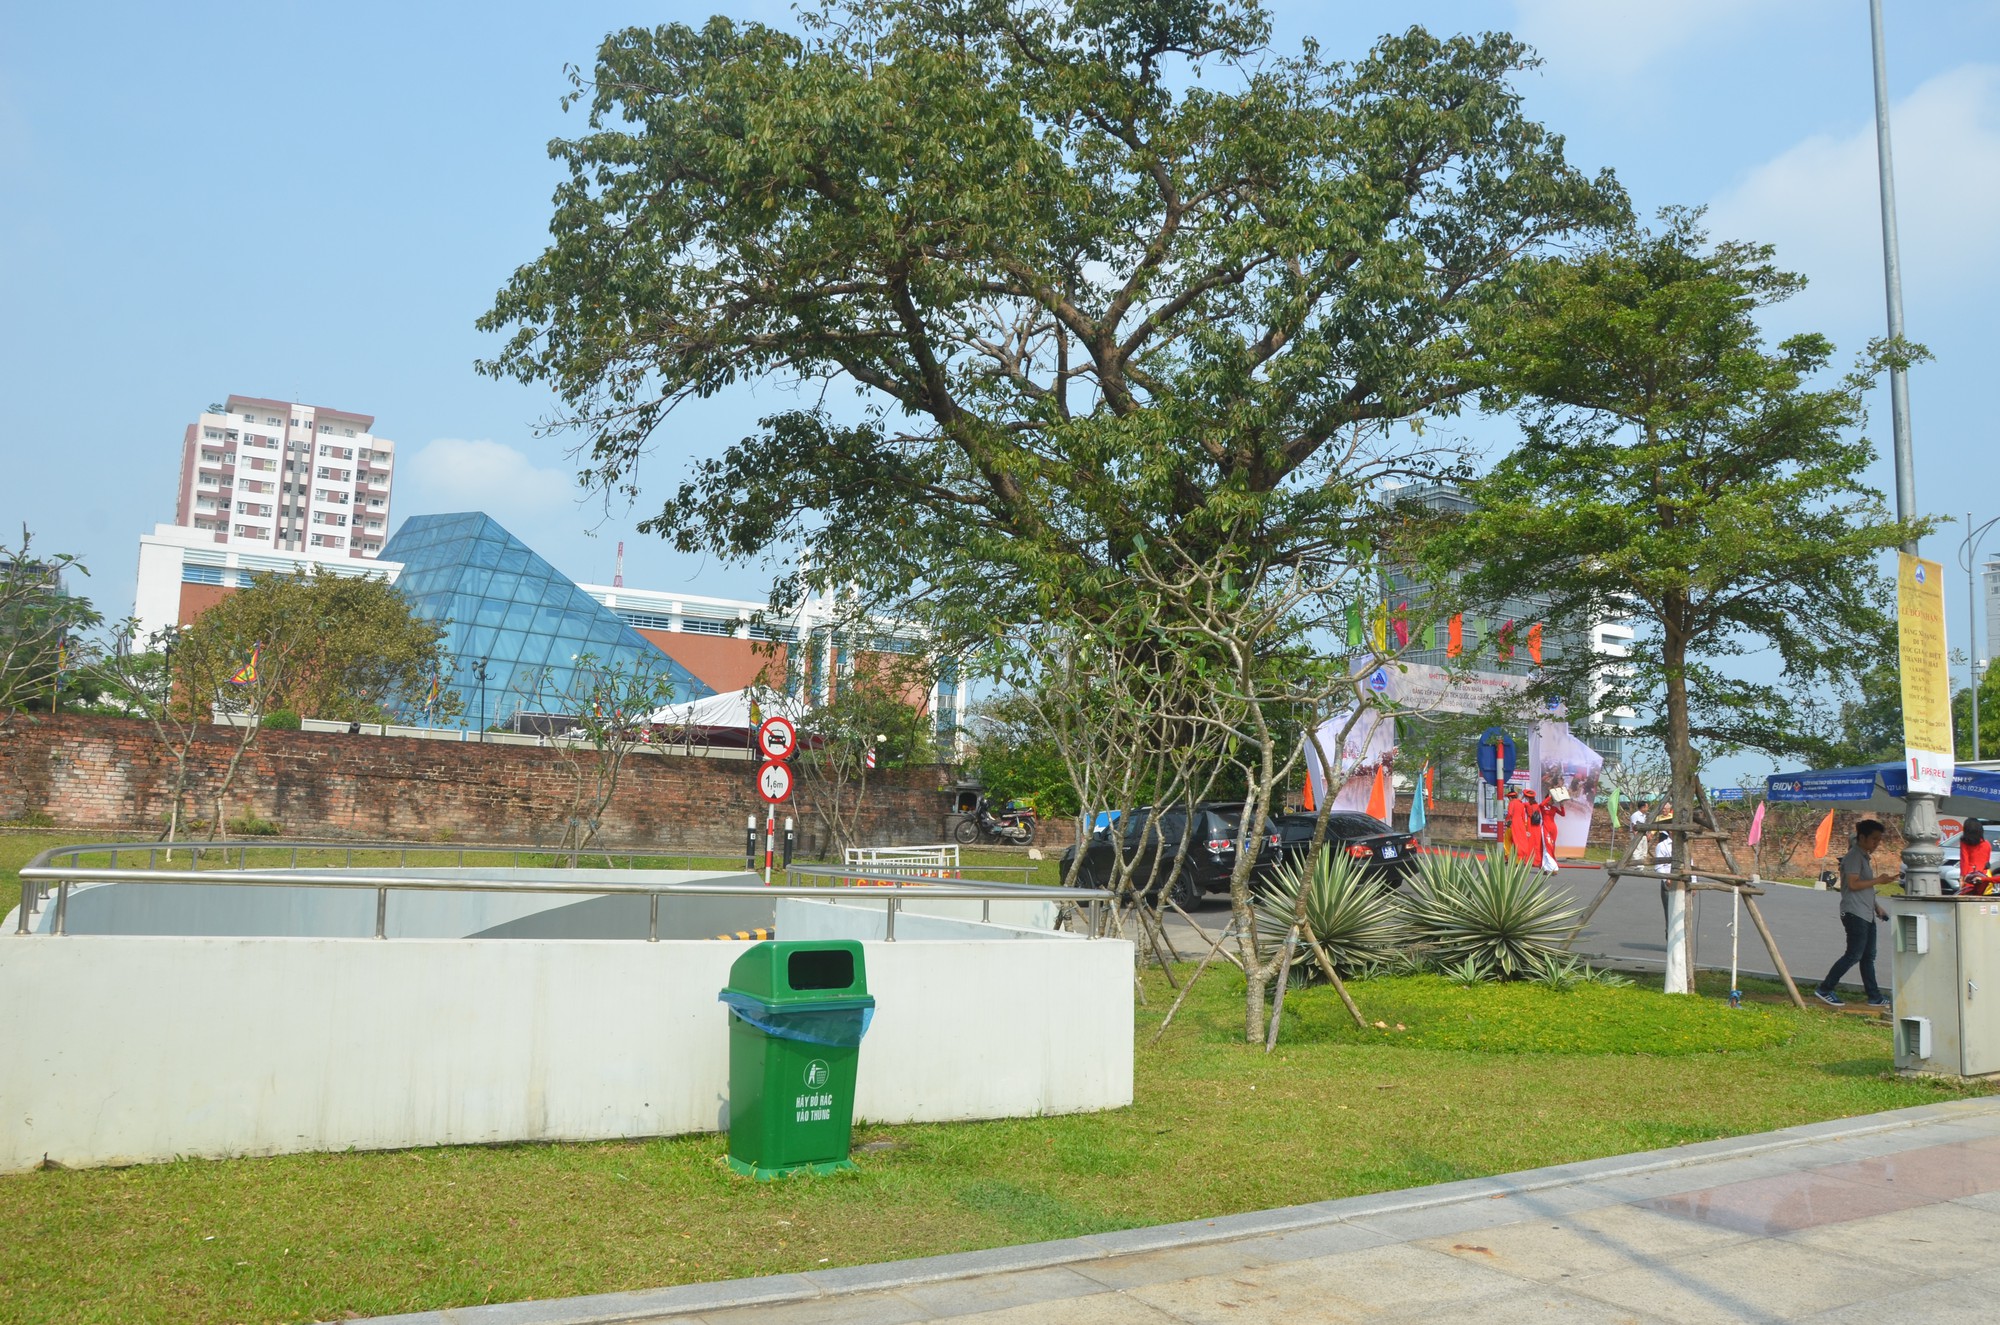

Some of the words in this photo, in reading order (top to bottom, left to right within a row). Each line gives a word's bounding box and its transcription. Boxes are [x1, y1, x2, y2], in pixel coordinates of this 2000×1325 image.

[765, 774, 783, 790] 1,6m
[1772, 782, 1793, 791] BIDV
[1956, 783, 1966, 791] Tel:
[1967, 785, 1988, 794] (0236)
[796, 1094, 810, 1108] HÃY
[810, 1092, 819, 1107] BỎ
[820, 1092, 832, 1106] RÁC
[796, 1108, 809, 1122] VÀO
[811, 1107, 830, 1121] THÙNG
